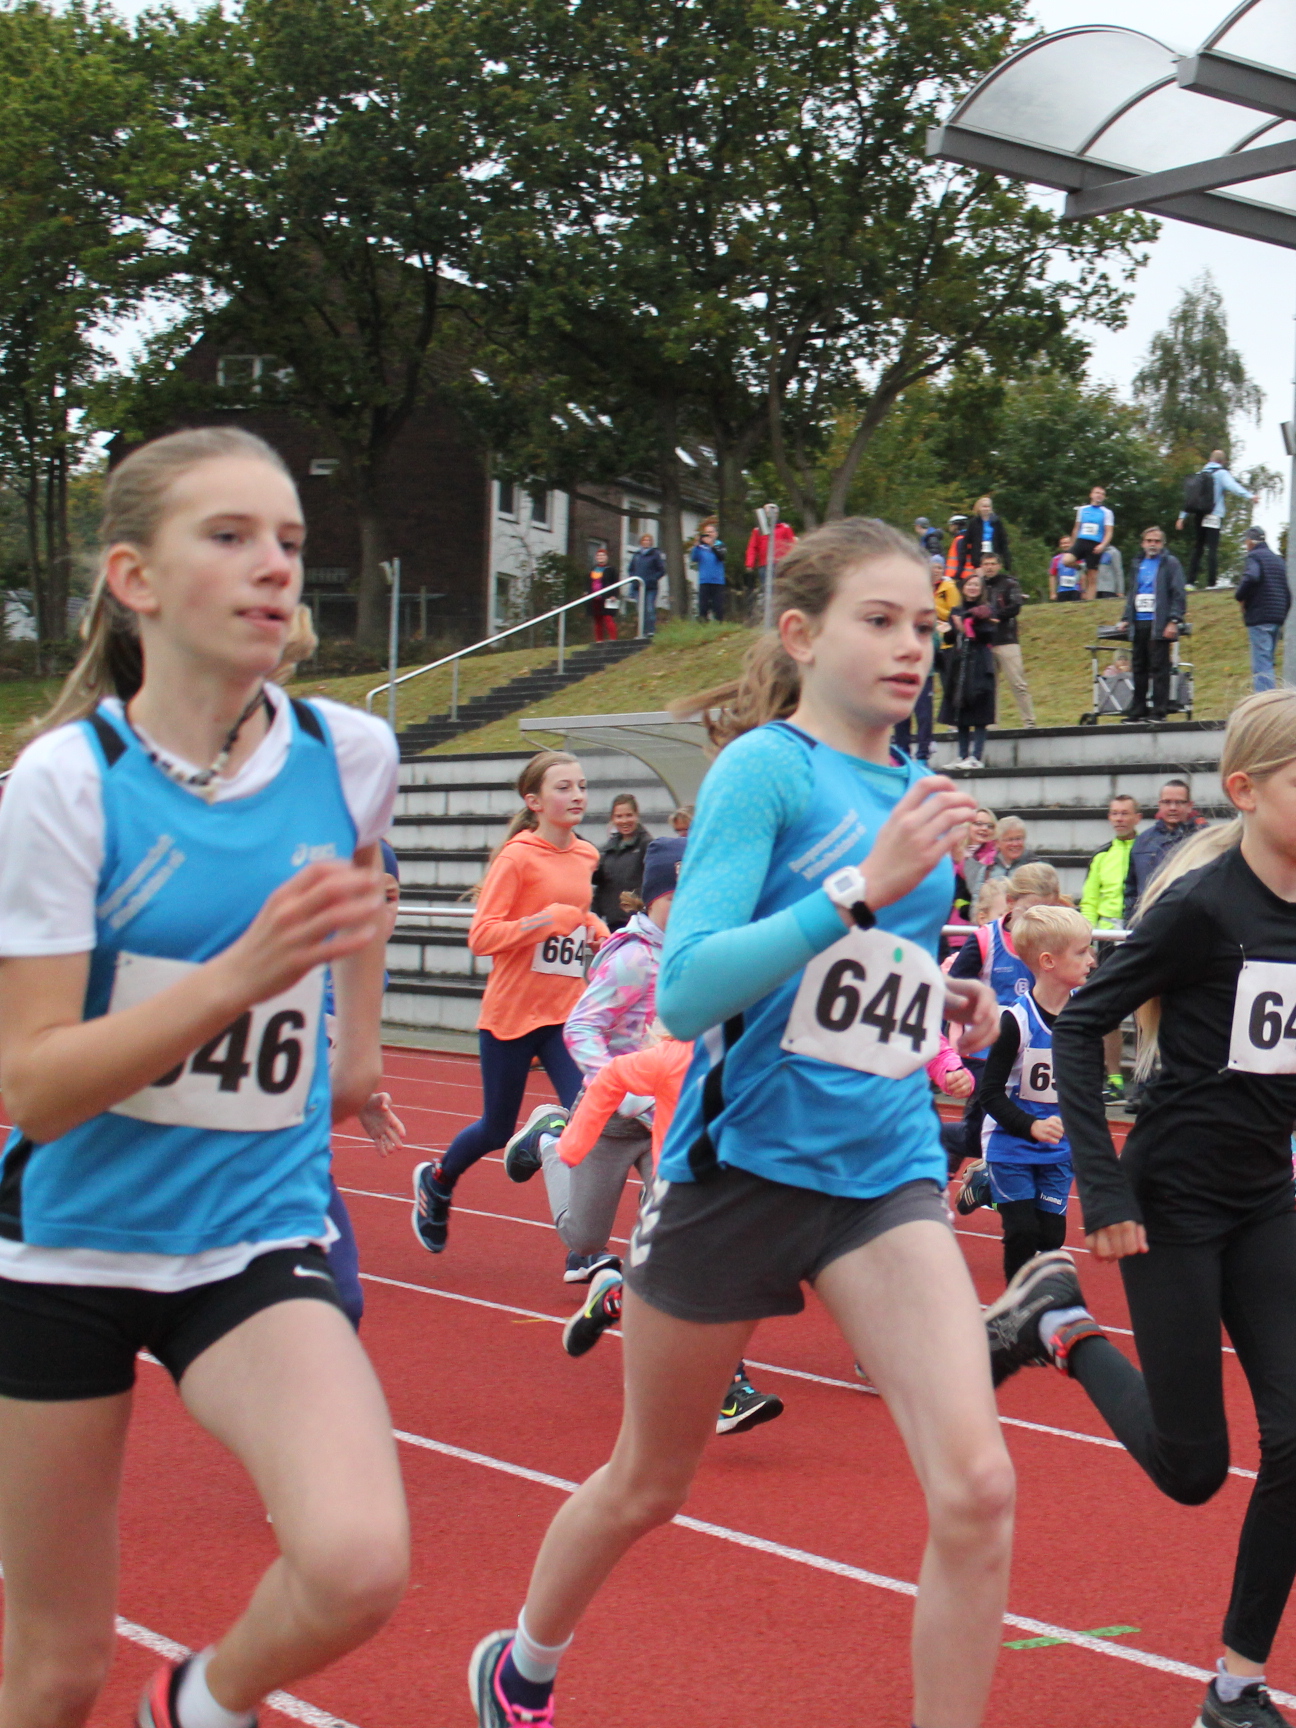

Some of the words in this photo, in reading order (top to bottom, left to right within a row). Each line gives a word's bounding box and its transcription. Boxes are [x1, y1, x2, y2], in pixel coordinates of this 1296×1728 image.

[815, 958, 931, 1053] 644
[152, 1009, 305, 1095] 46
[1029, 1062, 1059, 1092] 6
